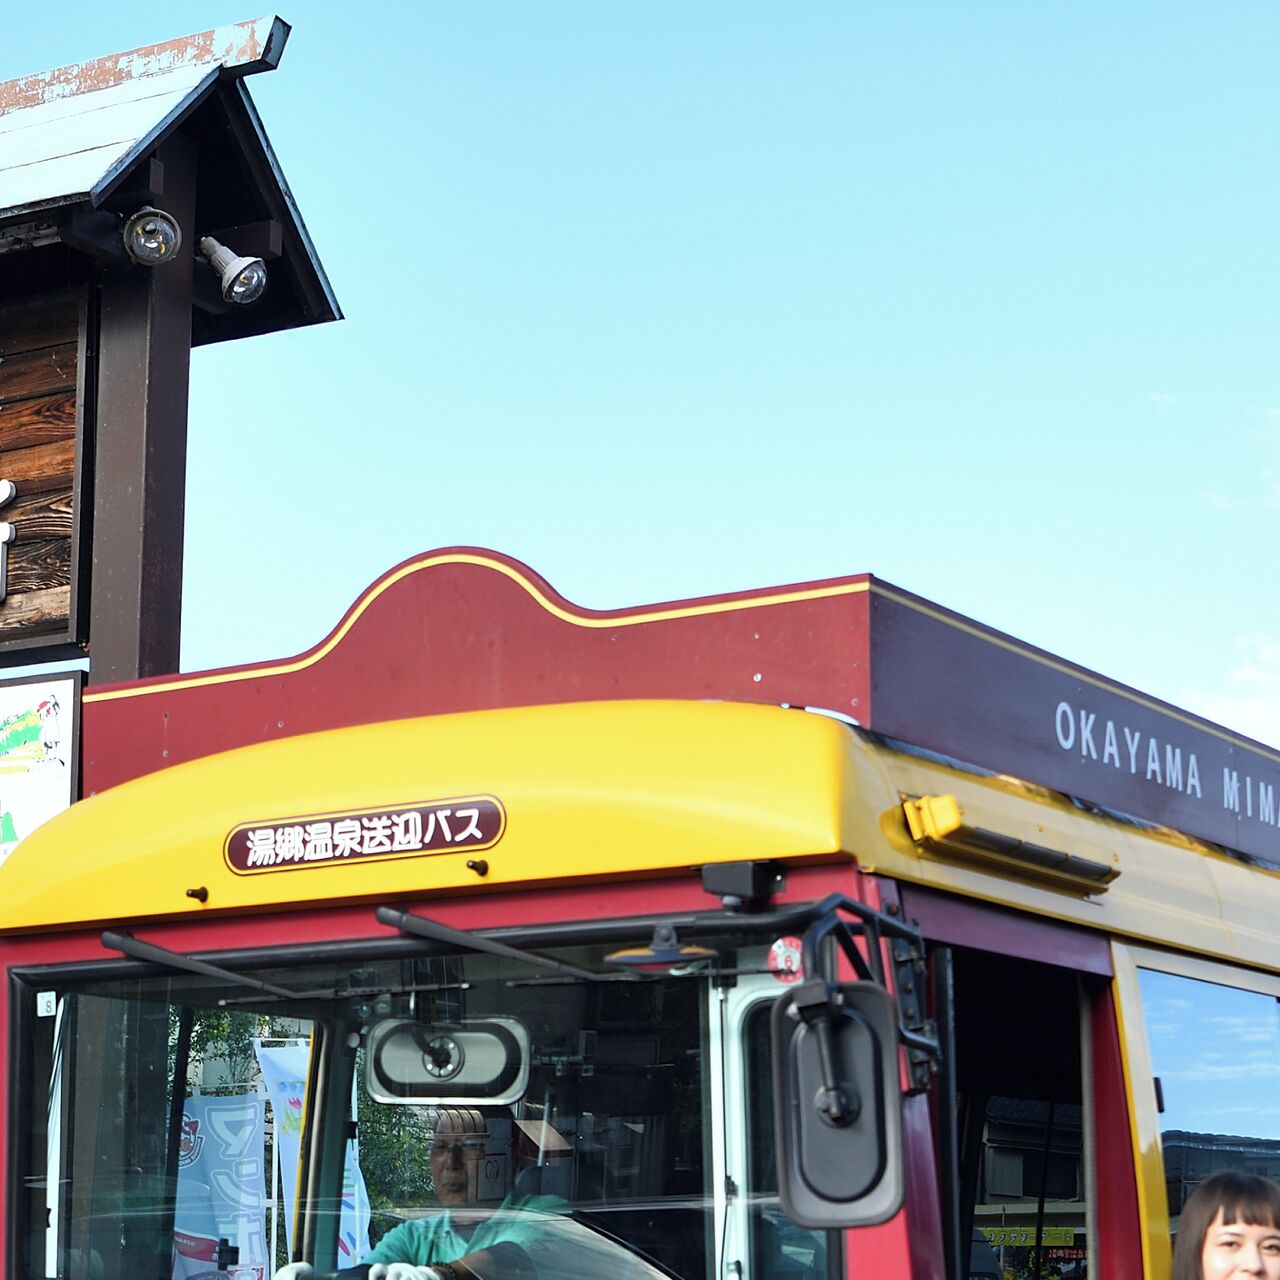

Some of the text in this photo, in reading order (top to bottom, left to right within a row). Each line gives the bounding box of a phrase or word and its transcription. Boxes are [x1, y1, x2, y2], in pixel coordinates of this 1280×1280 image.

[1055, 702, 1203, 799] OKAYAMA
[246, 808, 483, 867] 湯郷温泉送迎バス
